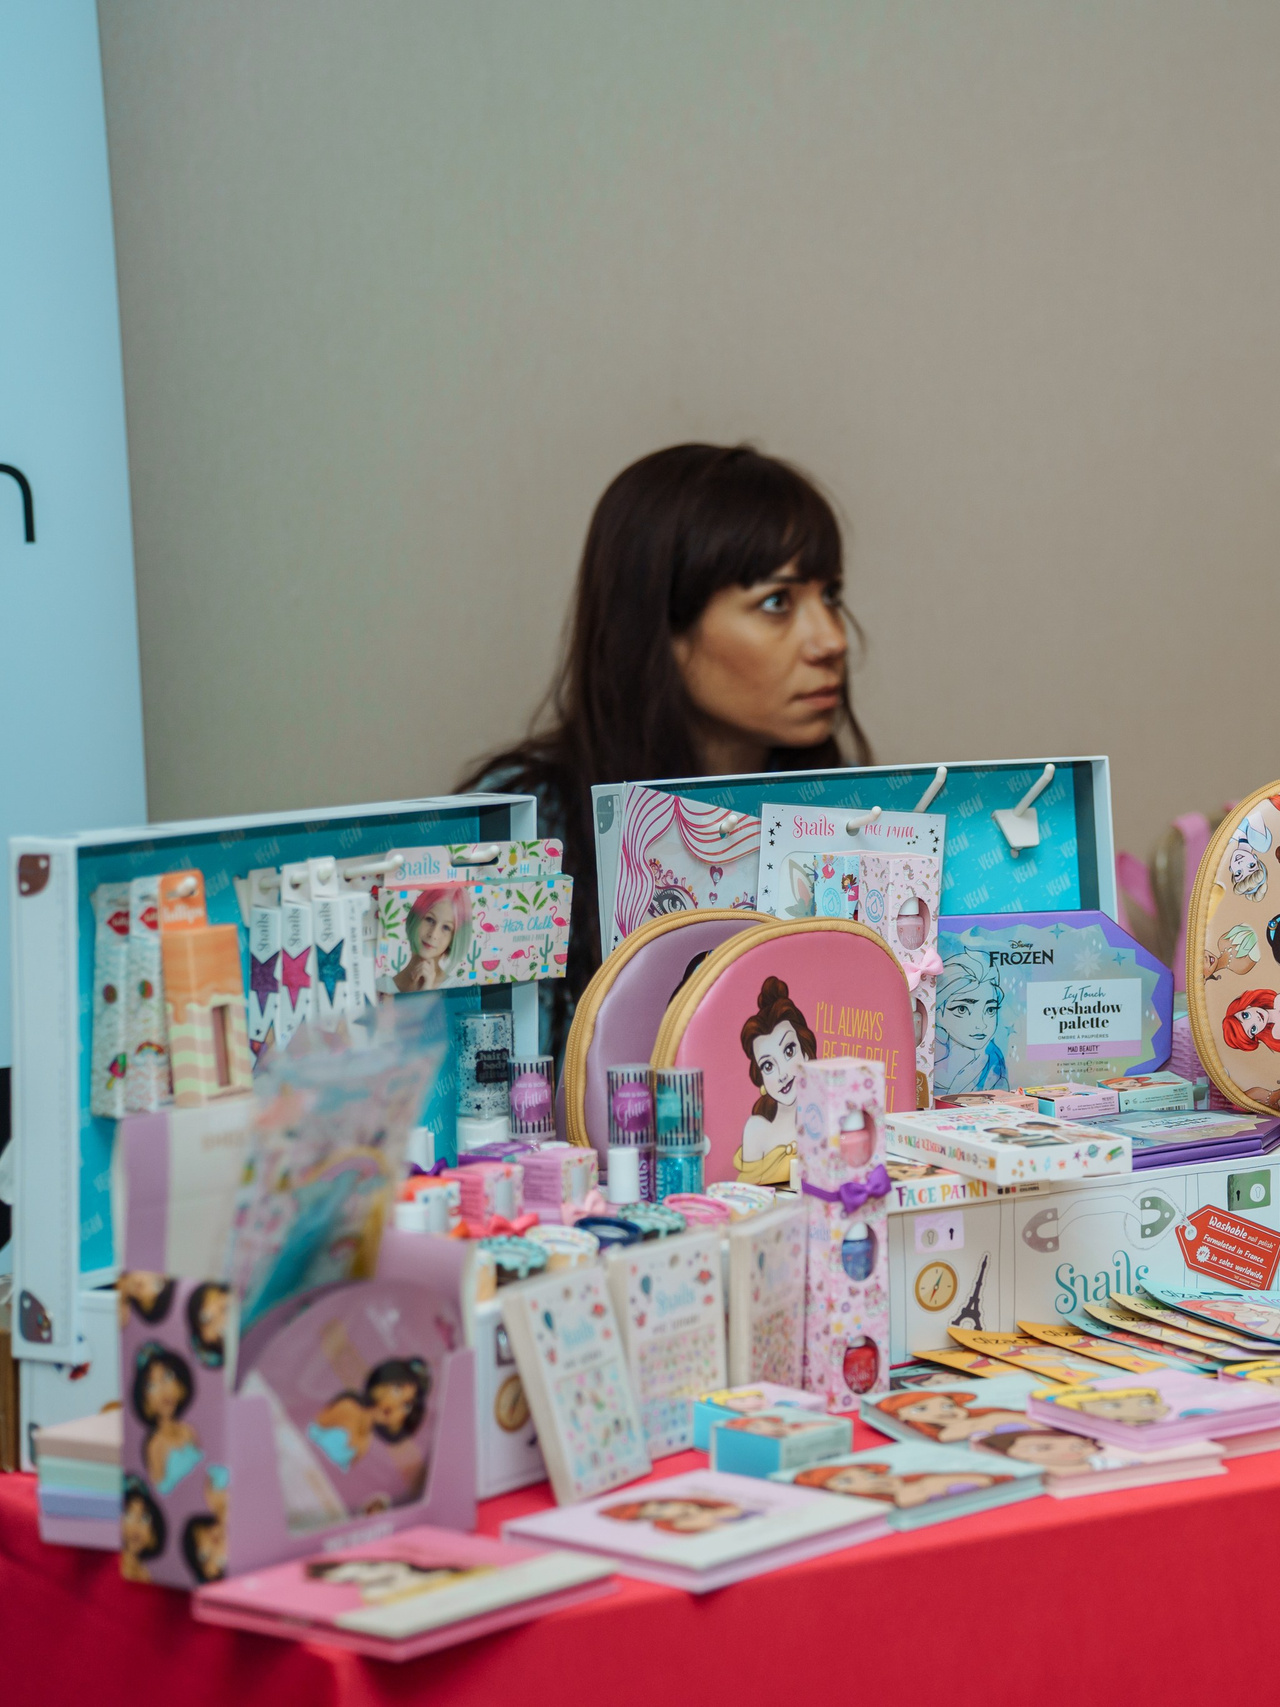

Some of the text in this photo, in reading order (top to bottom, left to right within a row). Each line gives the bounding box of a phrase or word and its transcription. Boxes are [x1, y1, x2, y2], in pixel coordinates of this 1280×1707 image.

[1006, 770, 1033, 793] VEGAN
[956, 794, 984, 819] VEGAN
[1040, 784, 1066, 807] VEGAN
[792, 814, 835, 839] Snails
[864, 824, 915, 838] FACE TATTOO
[944, 832, 970, 858] VEGAN
[978, 845, 1005, 871] VEGAN
[1012, 859, 1039, 884] VEGAN
[1045, 871, 1071, 897] VEGAN
[963, 884, 989, 909] VEGAN
[1008, 940, 1034, 950] Disney
[989, 949, 1054, 968] FROZEN
[1062, 985, 1106, 1003] Icy Touch
[815, 1001, 884, 1041] I'LL ALWAYS
[1043, 1001, 1122, 1019] eyeshadow
[1059, 1016, 1109, 1033] palette
[1067, 1045, 1078, 1053] MAD
[896, 1185, 937, 1207] FACE
[1209, 1216, 1248, 1239] Washable
[1203, 1233, 1265, 1264] Formulated in France
[1211, 1254, 1218, 1262] in
[1218, 1257, 1234, 1269] sales
[1235, 1263, 1264, 1280] worldwide
[1055, 1250, 1149, 1315] Snails
[973, 1335, 1028, 1345] dizao
